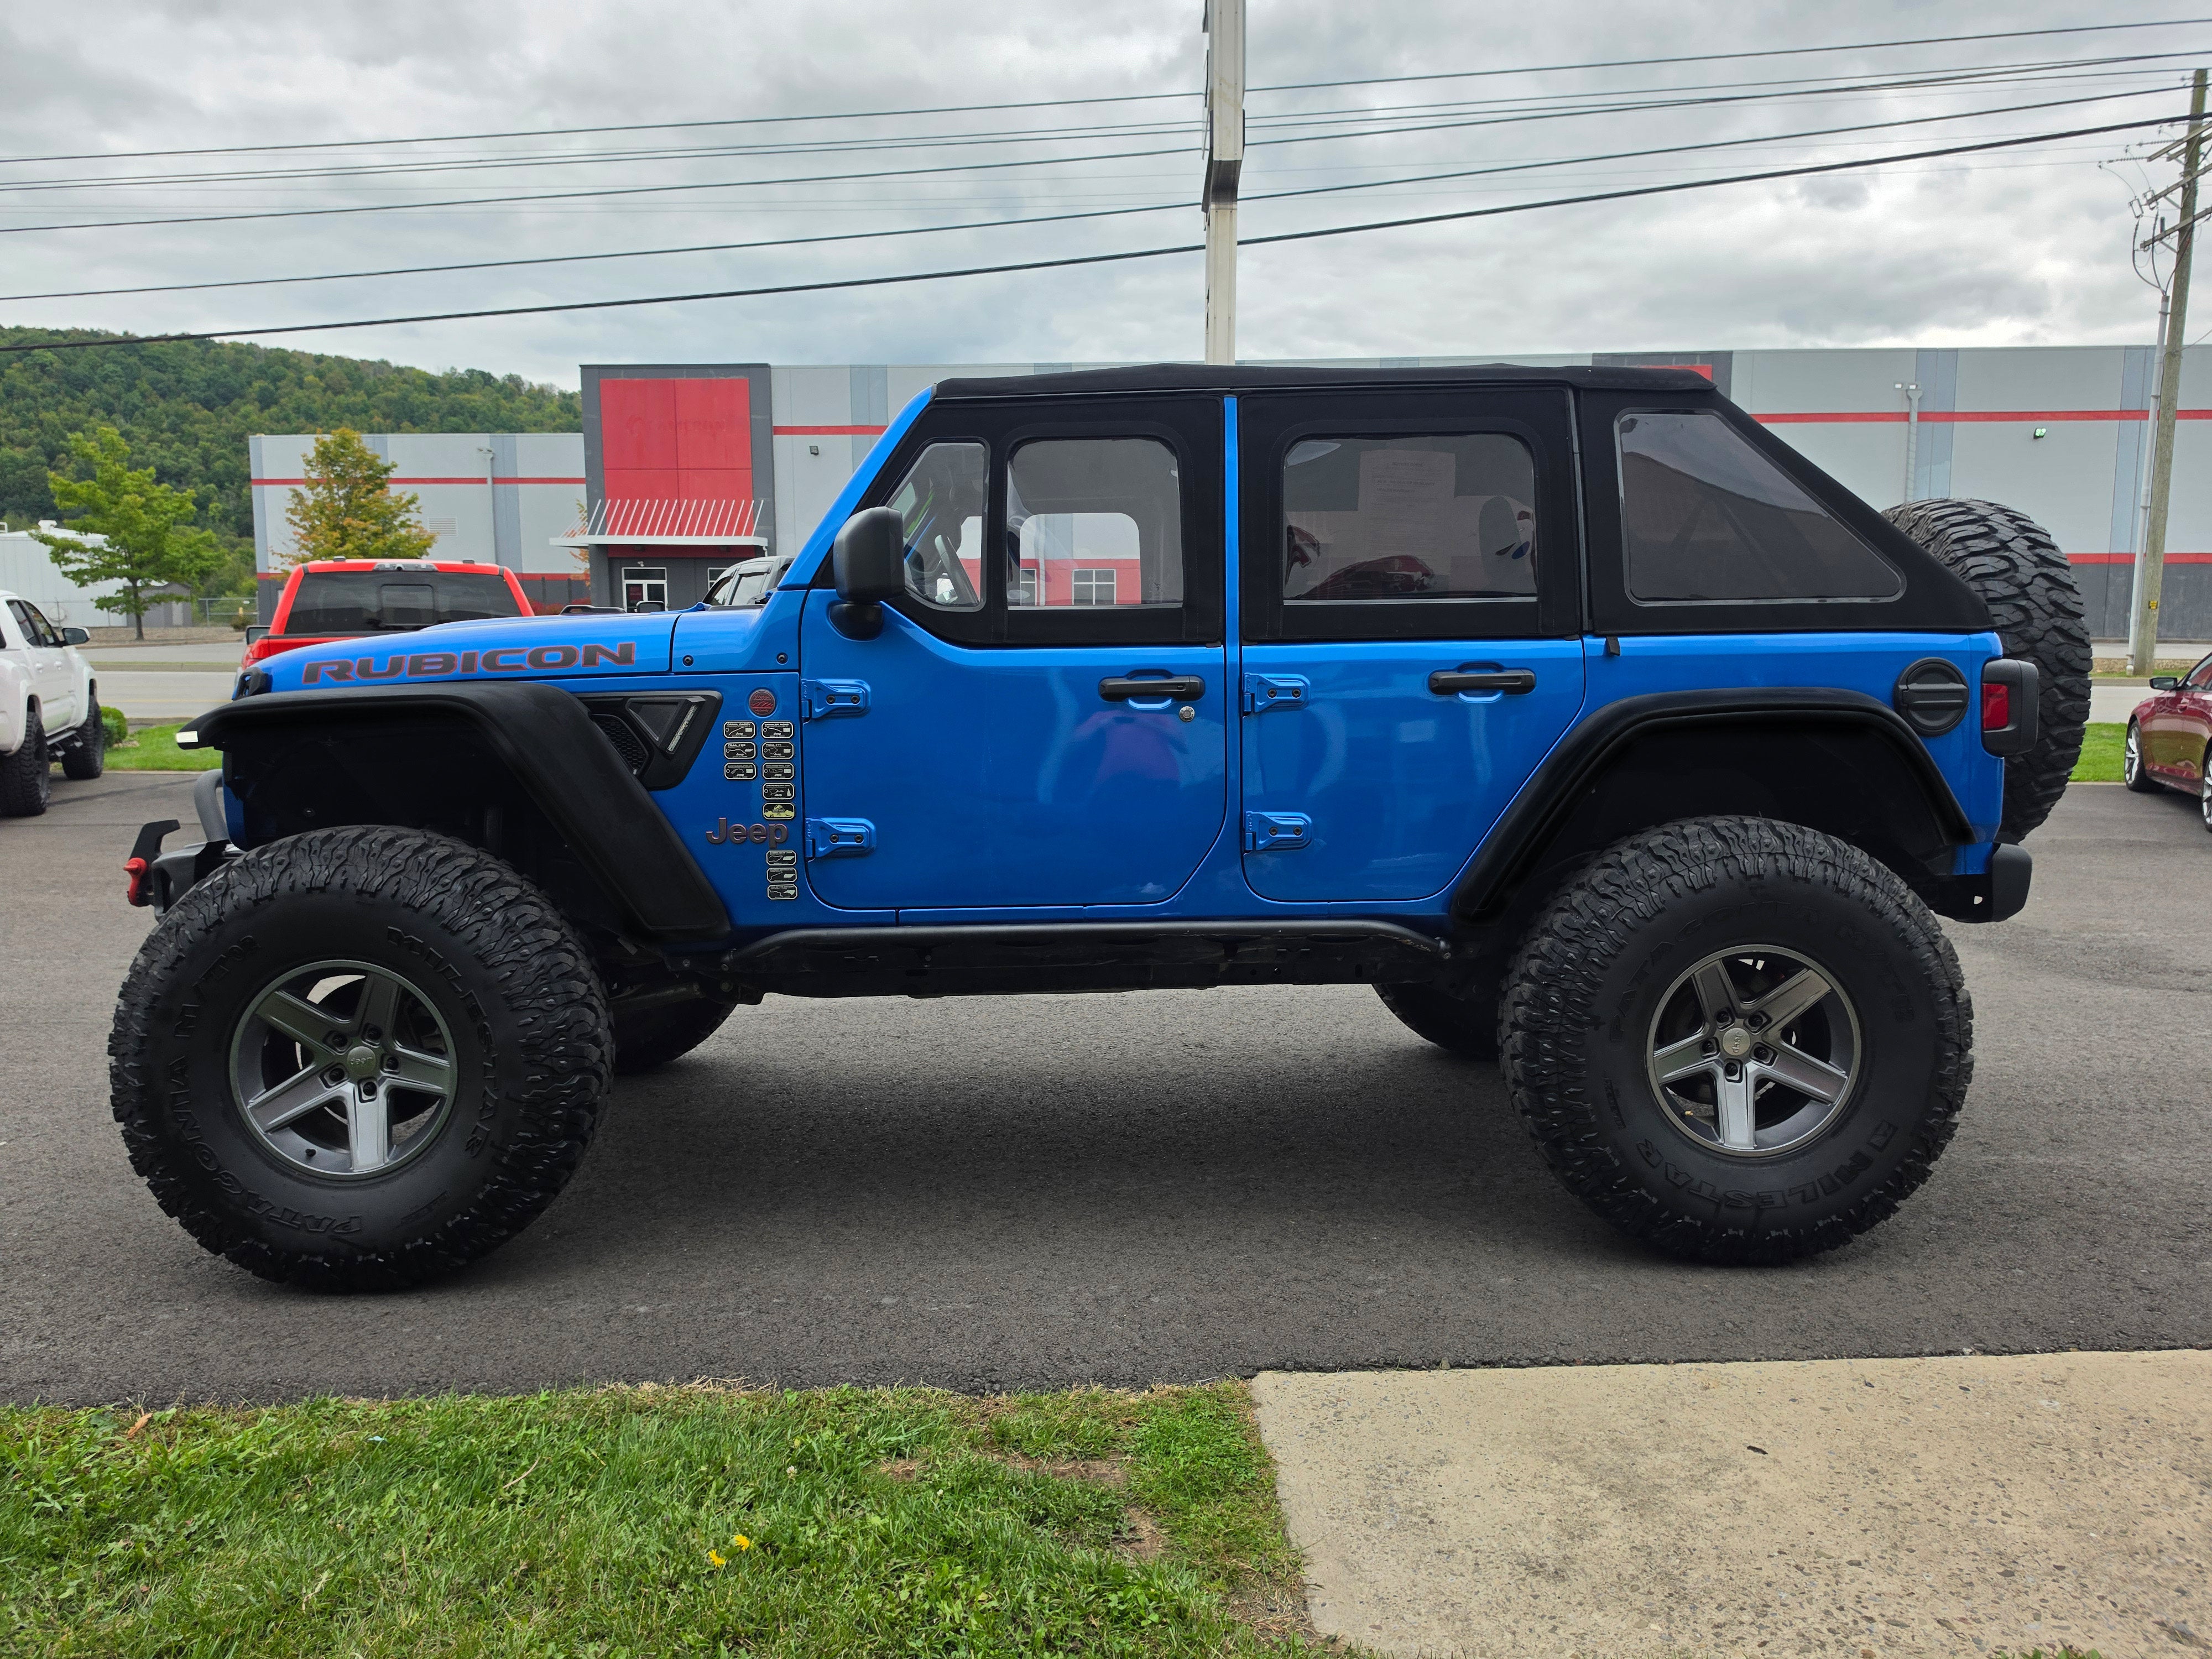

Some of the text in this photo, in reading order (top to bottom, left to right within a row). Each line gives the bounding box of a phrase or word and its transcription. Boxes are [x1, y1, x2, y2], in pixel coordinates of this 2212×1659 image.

[302, 642, 636, 685] RUBICON
[706, 817, 789, 848] Jeep
[387, 925, 498, 1157] MILESTAR
[168, 1055, 362, 1234] PATAGONIA
[1635, 1138, 1874, 1210] MILESTAR
